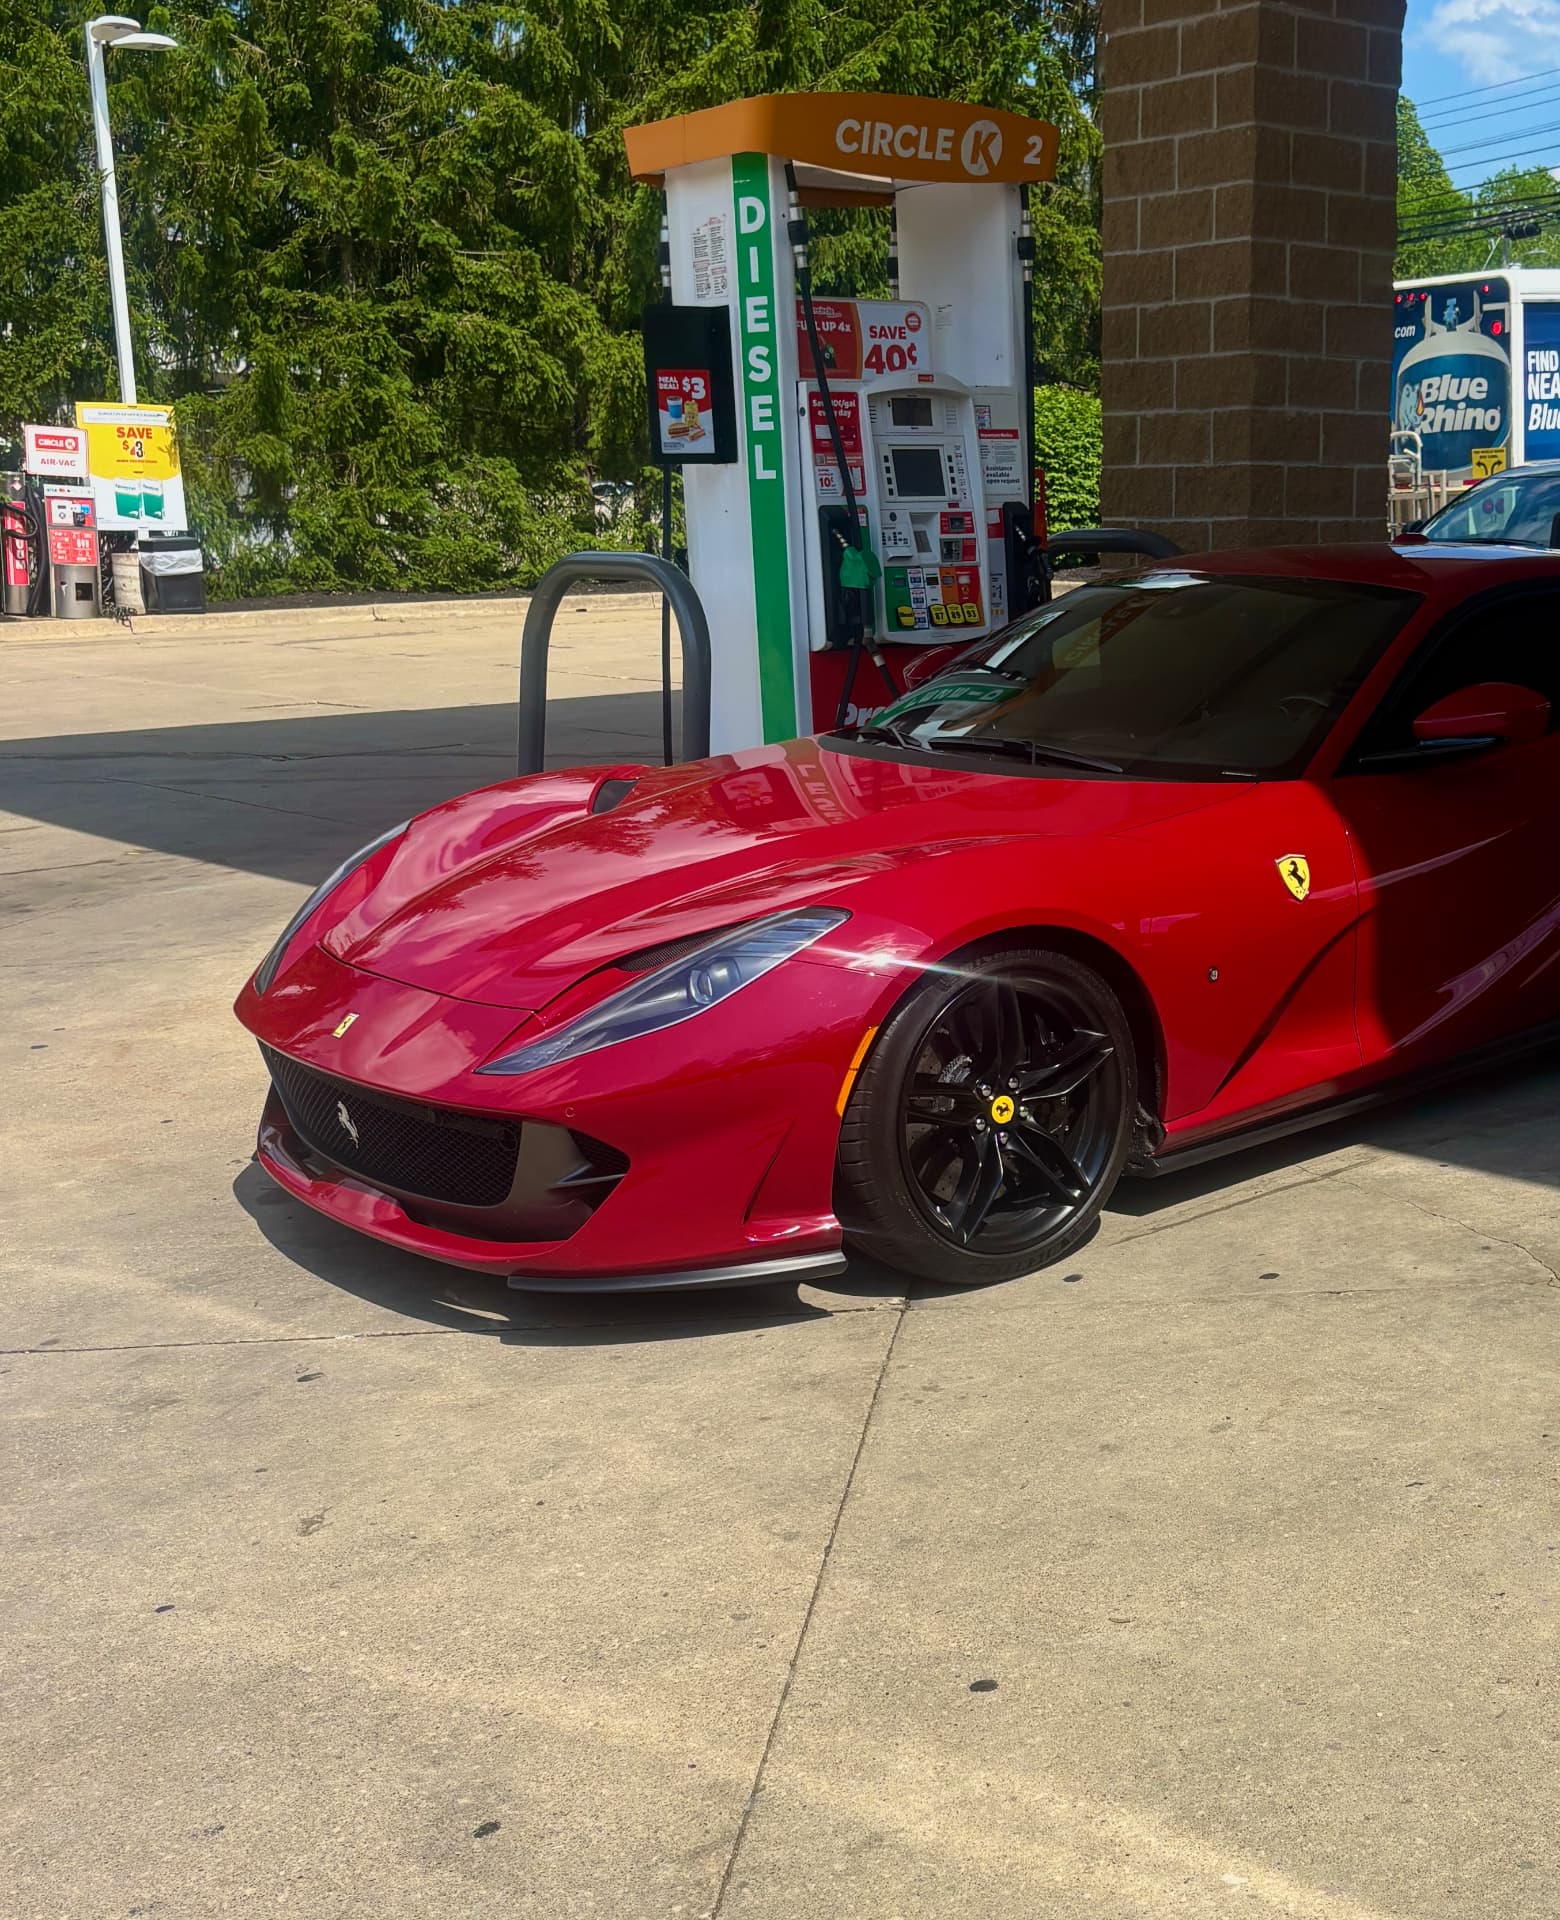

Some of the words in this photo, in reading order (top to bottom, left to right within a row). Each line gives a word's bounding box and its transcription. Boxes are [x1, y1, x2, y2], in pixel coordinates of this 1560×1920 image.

[835, 119, 955, 161] CIRCLE
[963, 123, 1002, 173] K
[1023, 135, 1043, 165] 2
[738, 196, 777, 480] DIESEL
[821, 321, 837, 332] UP
[869, 325, 907, 340] SAVE
[864, 342, 917, 374] 40¢
[1527, 350, 1559, 372] FIND
[682, 376, 706, 400] $3
[1420, 373, 1488, 403] Blue
[1416, 401, 1500, 434] Rhino
[116, 426, 153, 440] SAVE
[40, 458, 76, 467] AIR-VAC
